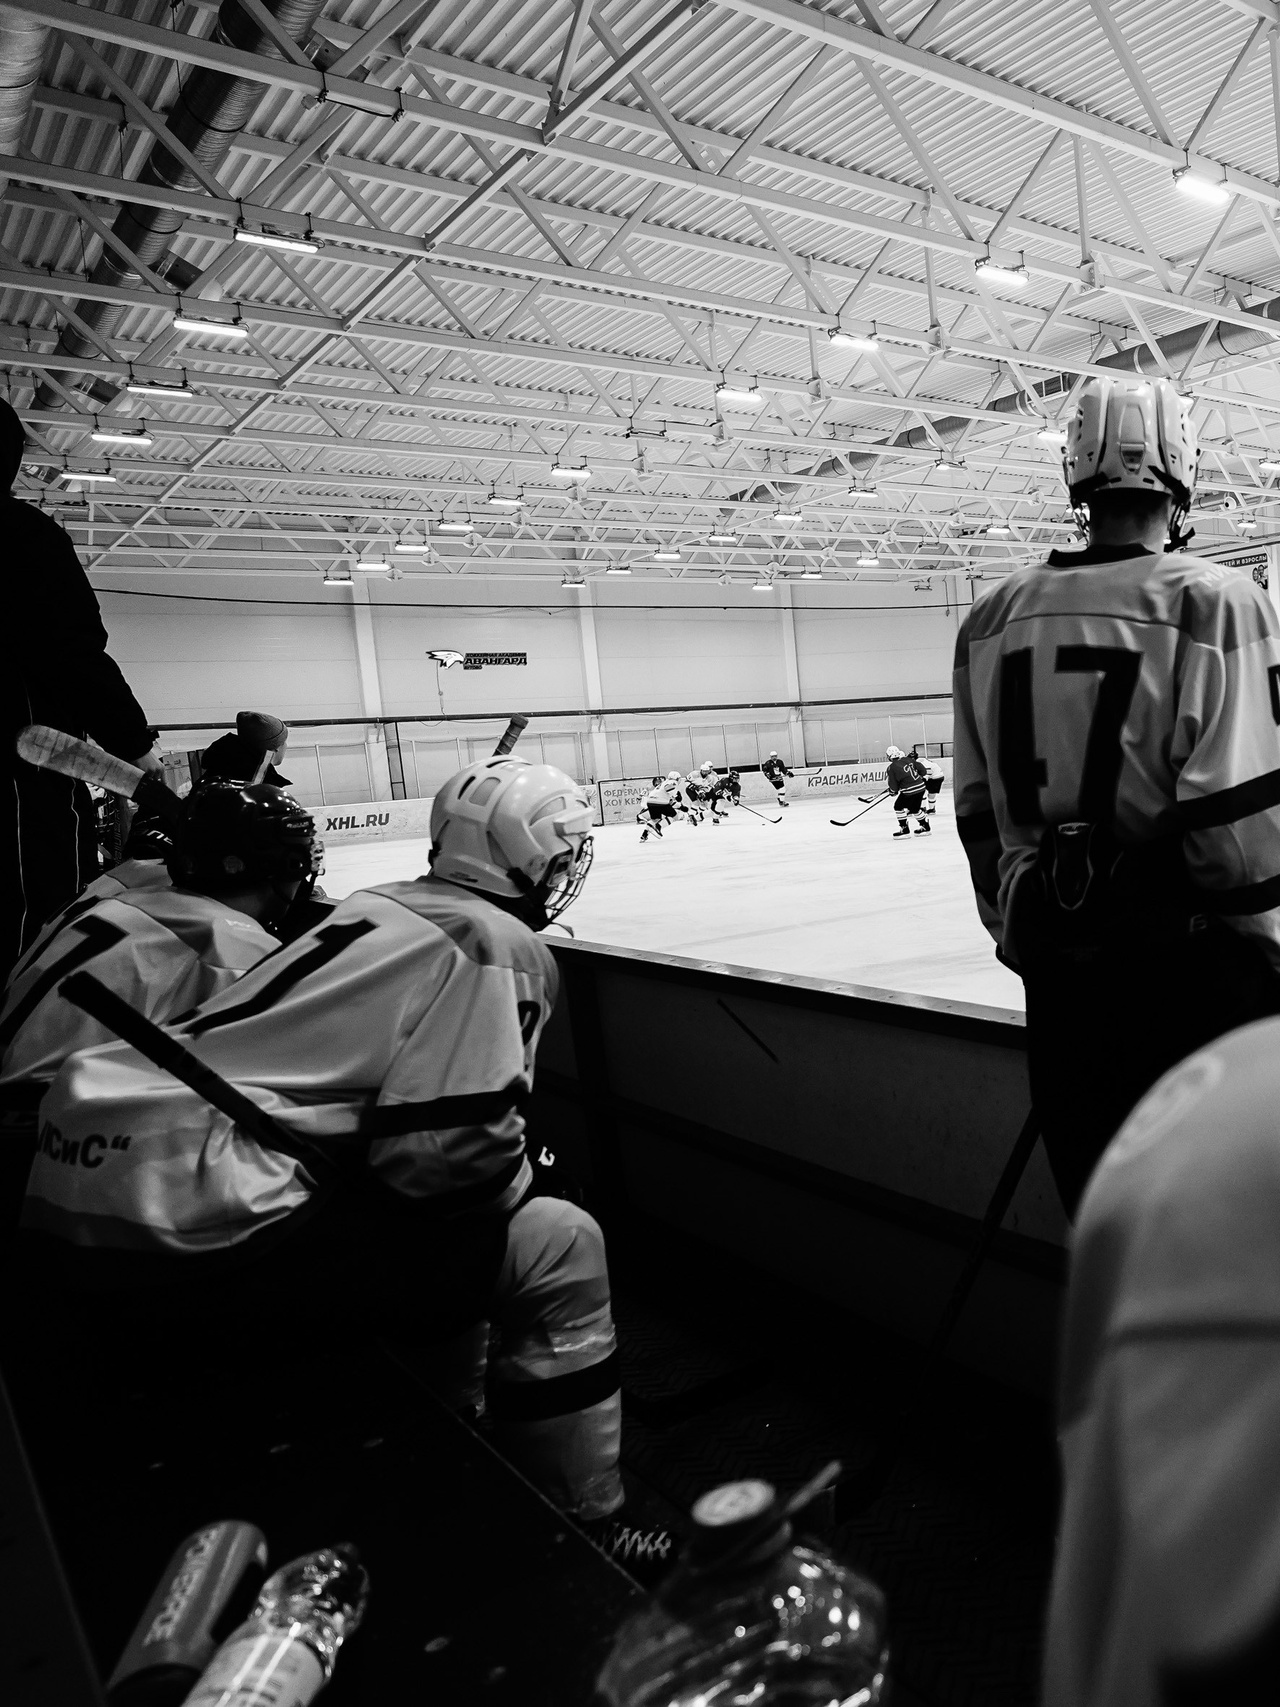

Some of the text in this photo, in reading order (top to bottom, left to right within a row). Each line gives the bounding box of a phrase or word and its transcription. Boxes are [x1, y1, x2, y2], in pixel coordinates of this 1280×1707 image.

[465, 657, 527, 666] АВАНГАРД
[808, 773, 858, 787] КРАСНАЯ
[325, 813, 390, 831] XHL.RU
